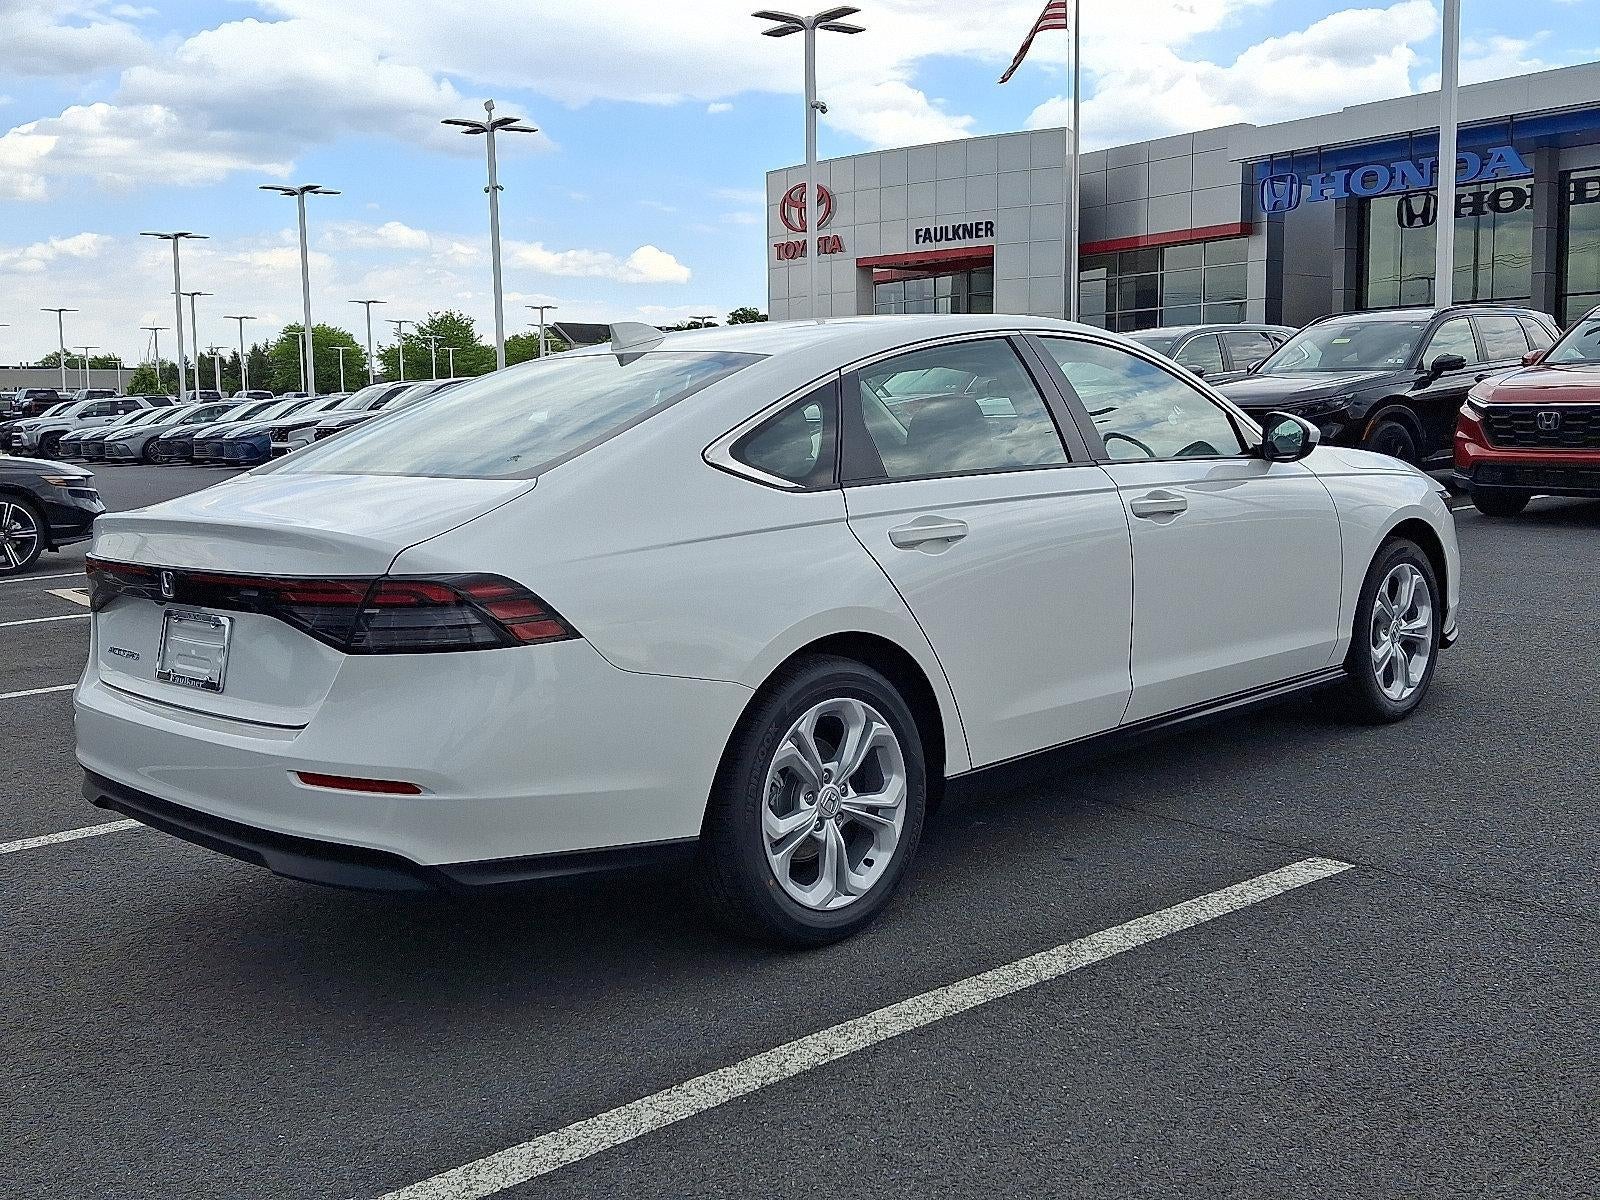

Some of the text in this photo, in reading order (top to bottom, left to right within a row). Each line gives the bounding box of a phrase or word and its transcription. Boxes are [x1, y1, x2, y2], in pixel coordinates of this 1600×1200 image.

[1306, 146, 1533, 202] HONDA
[914, 220, 995, 245] FAULKNER
[773, 234, 844, 261] TOYTA
[170, 673, 201, 688] Faulkner
